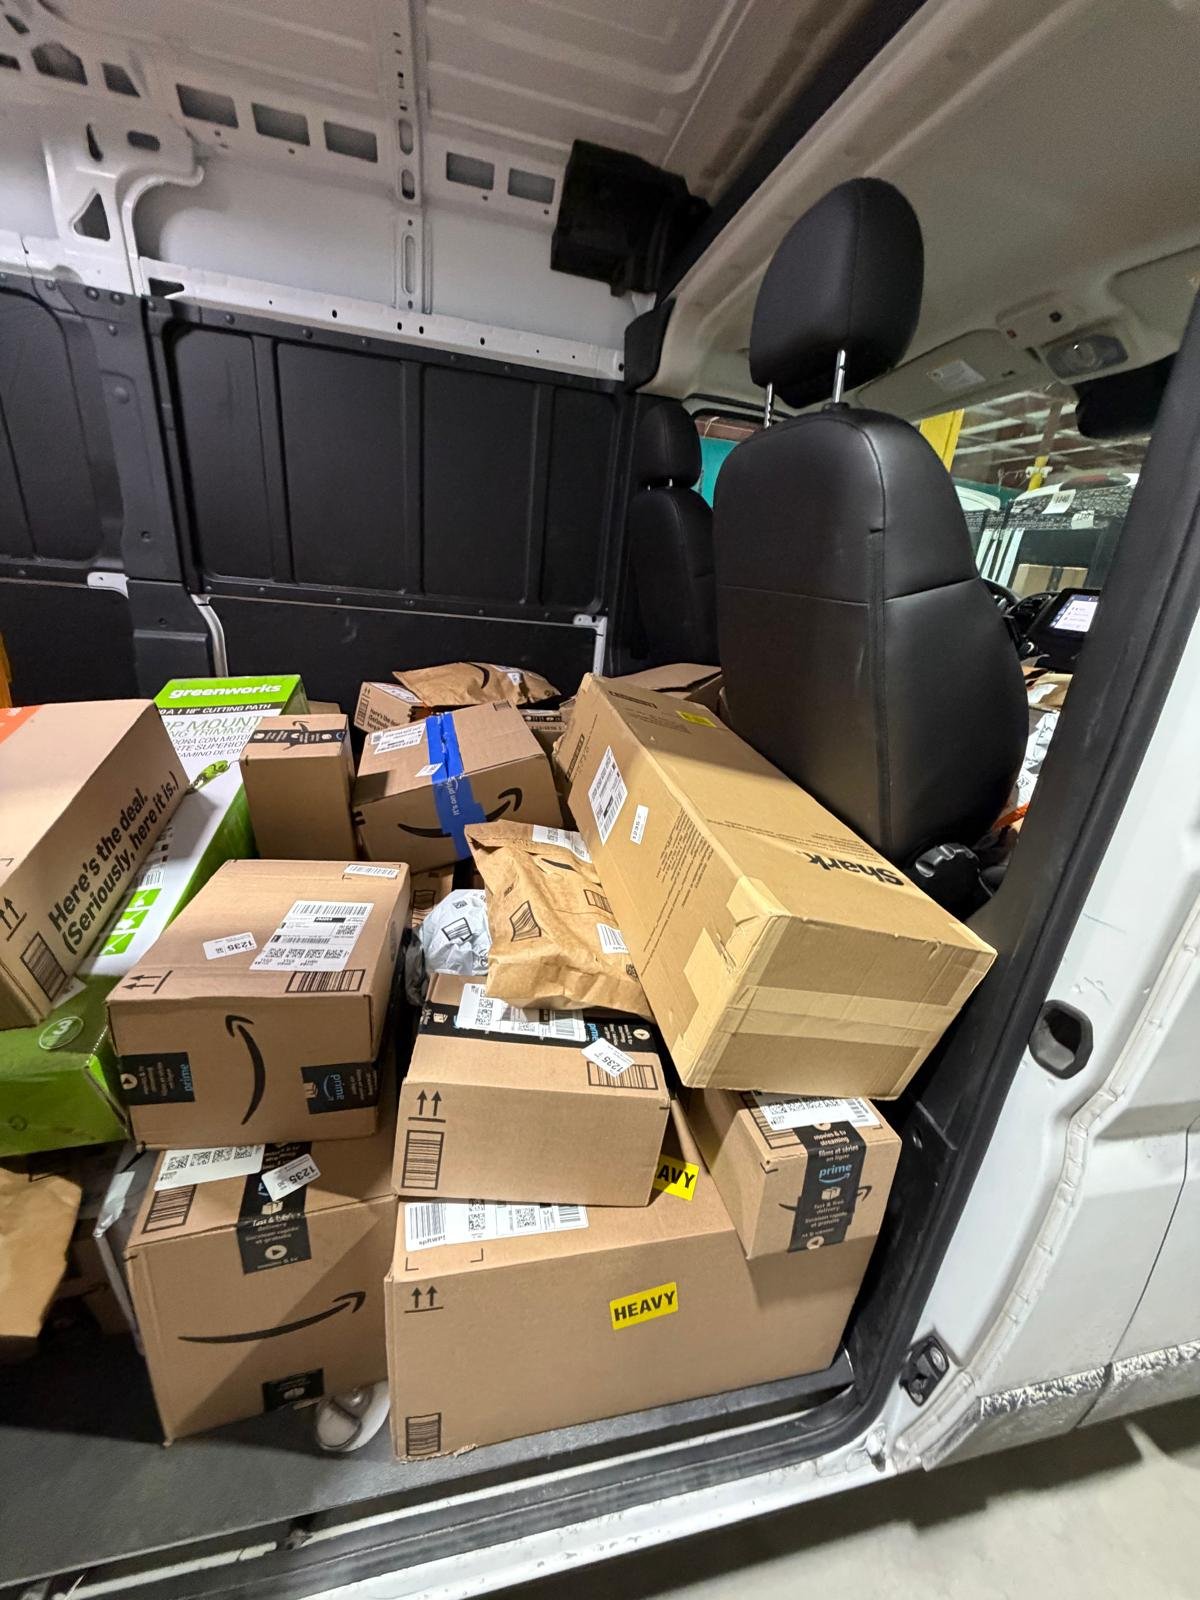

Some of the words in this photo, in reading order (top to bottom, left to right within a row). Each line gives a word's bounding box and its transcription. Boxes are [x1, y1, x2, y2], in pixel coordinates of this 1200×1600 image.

[169, 684, 282, 699] greenworks
[202, 706, 244, 714] CUTTING
[48, 857, 100, 933] Here's
[95, 825, 122, 862] the
[120, 787, 148, 831] deal.
[62, 848, 136, 955] (Seriously,
[128, 807, 157, 850] here
[153, 793, 166, 814] it
[162, 771, 179, 801] is.)
[803, 851, 904, 886] Shark
[602, 1056, 624, 1072] 1235
[180, 1064, 193, 1092] prime
[331, 1074, 345, 1100] prime
[289, 1165, 316, 1184] 1235
[657, 1165, 695, 1188] AVY
[819, 1164, 852, 1179] prime
[613, 1290, 676, 1321] HEAVY
